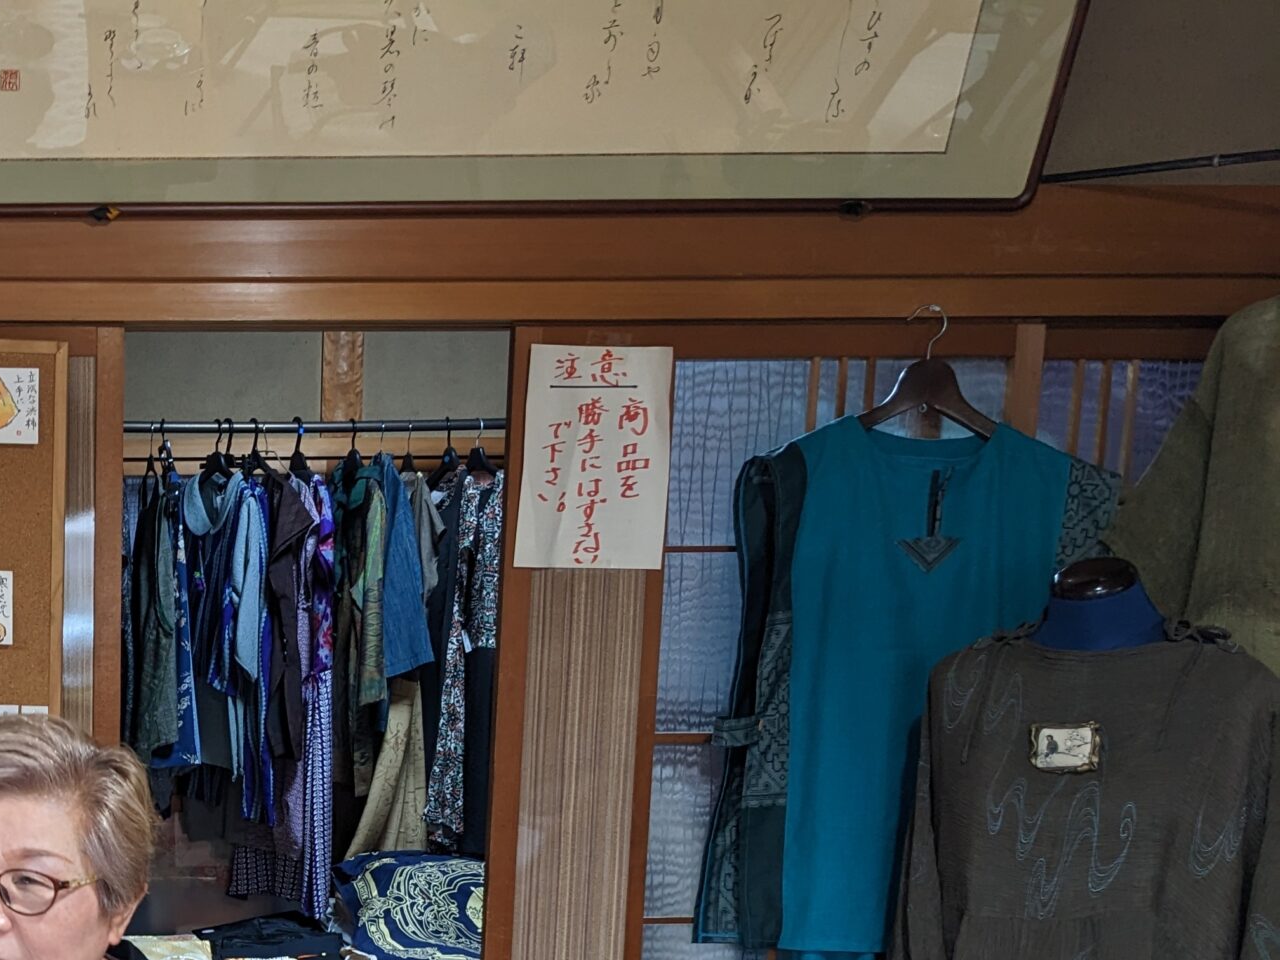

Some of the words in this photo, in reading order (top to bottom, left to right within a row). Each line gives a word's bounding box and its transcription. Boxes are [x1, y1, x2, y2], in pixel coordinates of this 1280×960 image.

[554, 348, 628, 387] 注意
[572, 396, 610, 565] 勝手にはずさない
[616, 397, 651, 500] 商品を
